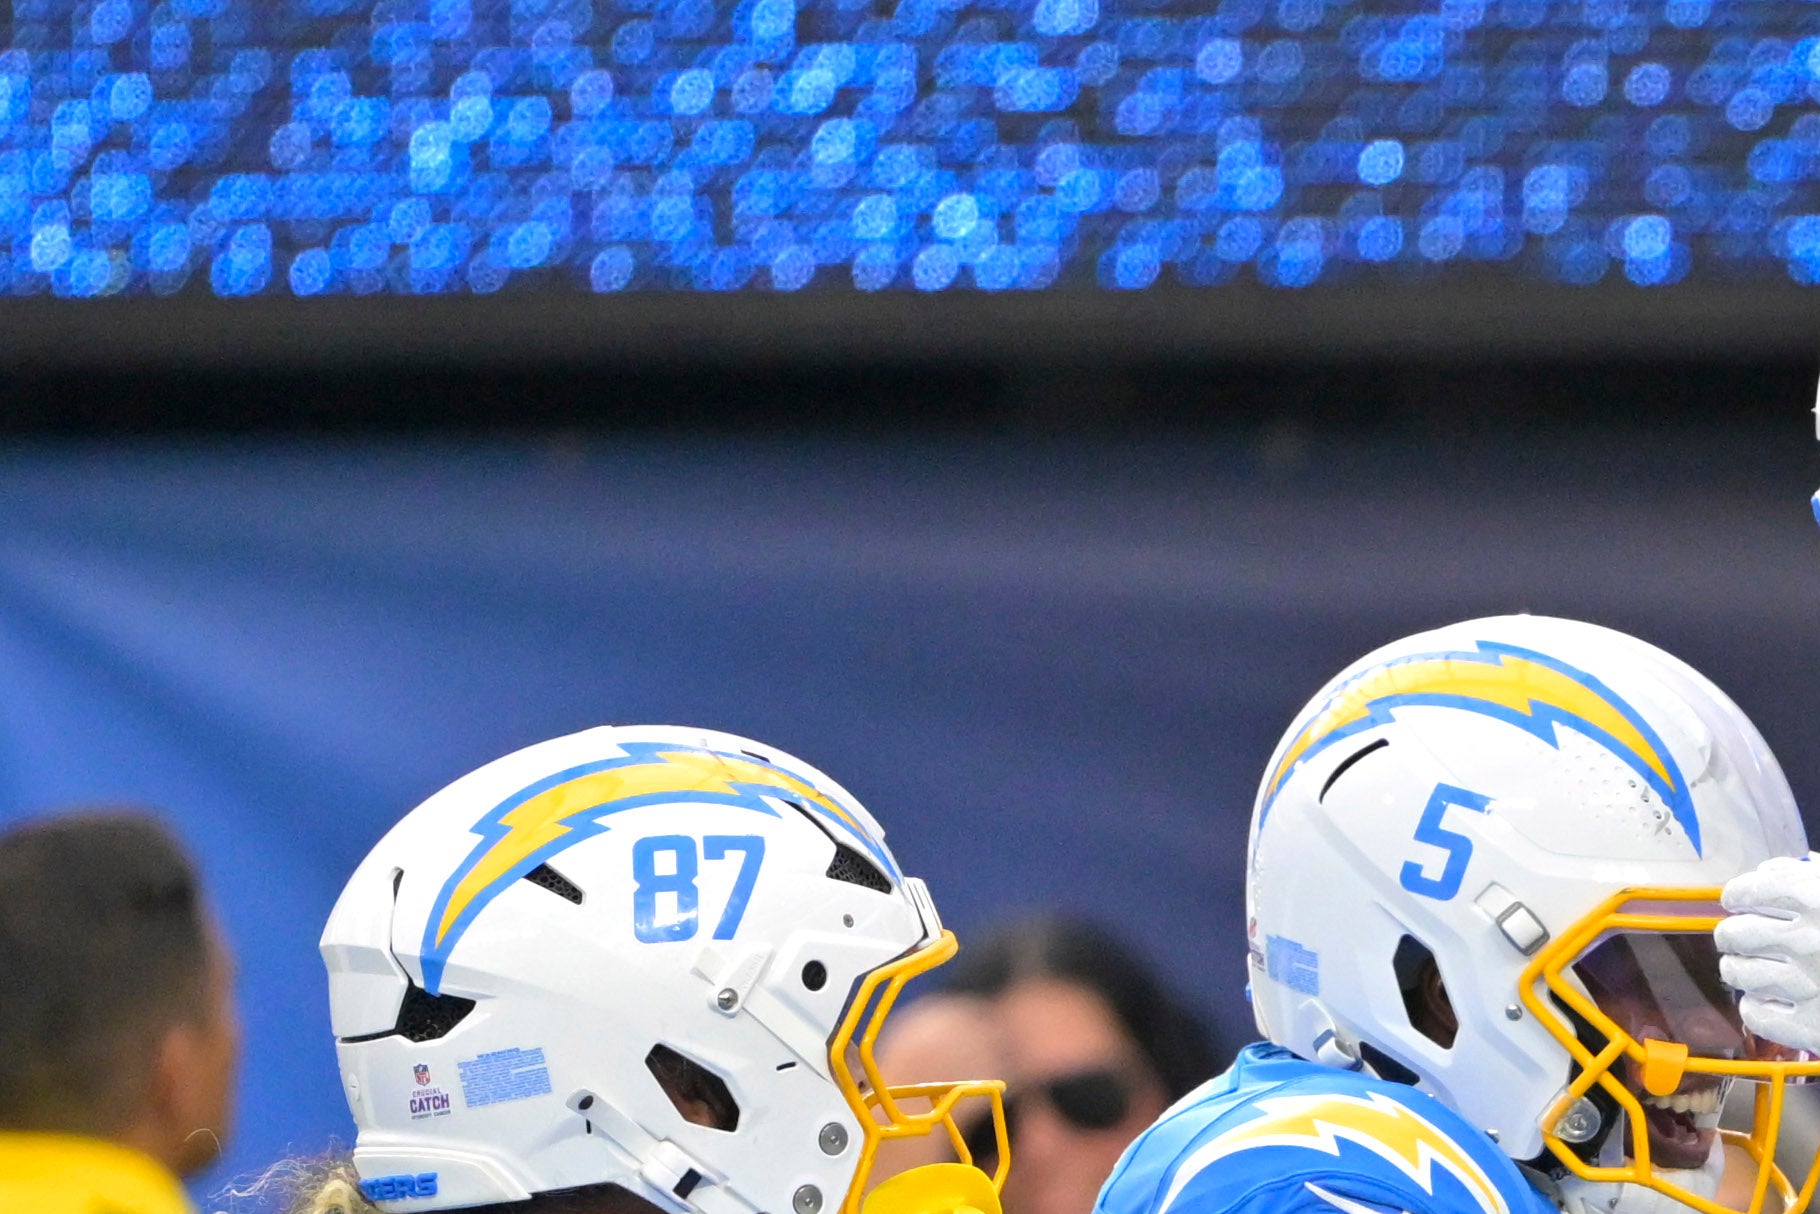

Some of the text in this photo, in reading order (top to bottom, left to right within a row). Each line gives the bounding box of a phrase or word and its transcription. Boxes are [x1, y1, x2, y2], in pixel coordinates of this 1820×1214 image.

[632, 834, 766, 944] 87
[1400, 782, 1496, 902] 5
[409, 1093, 450, 1114] CATCH
